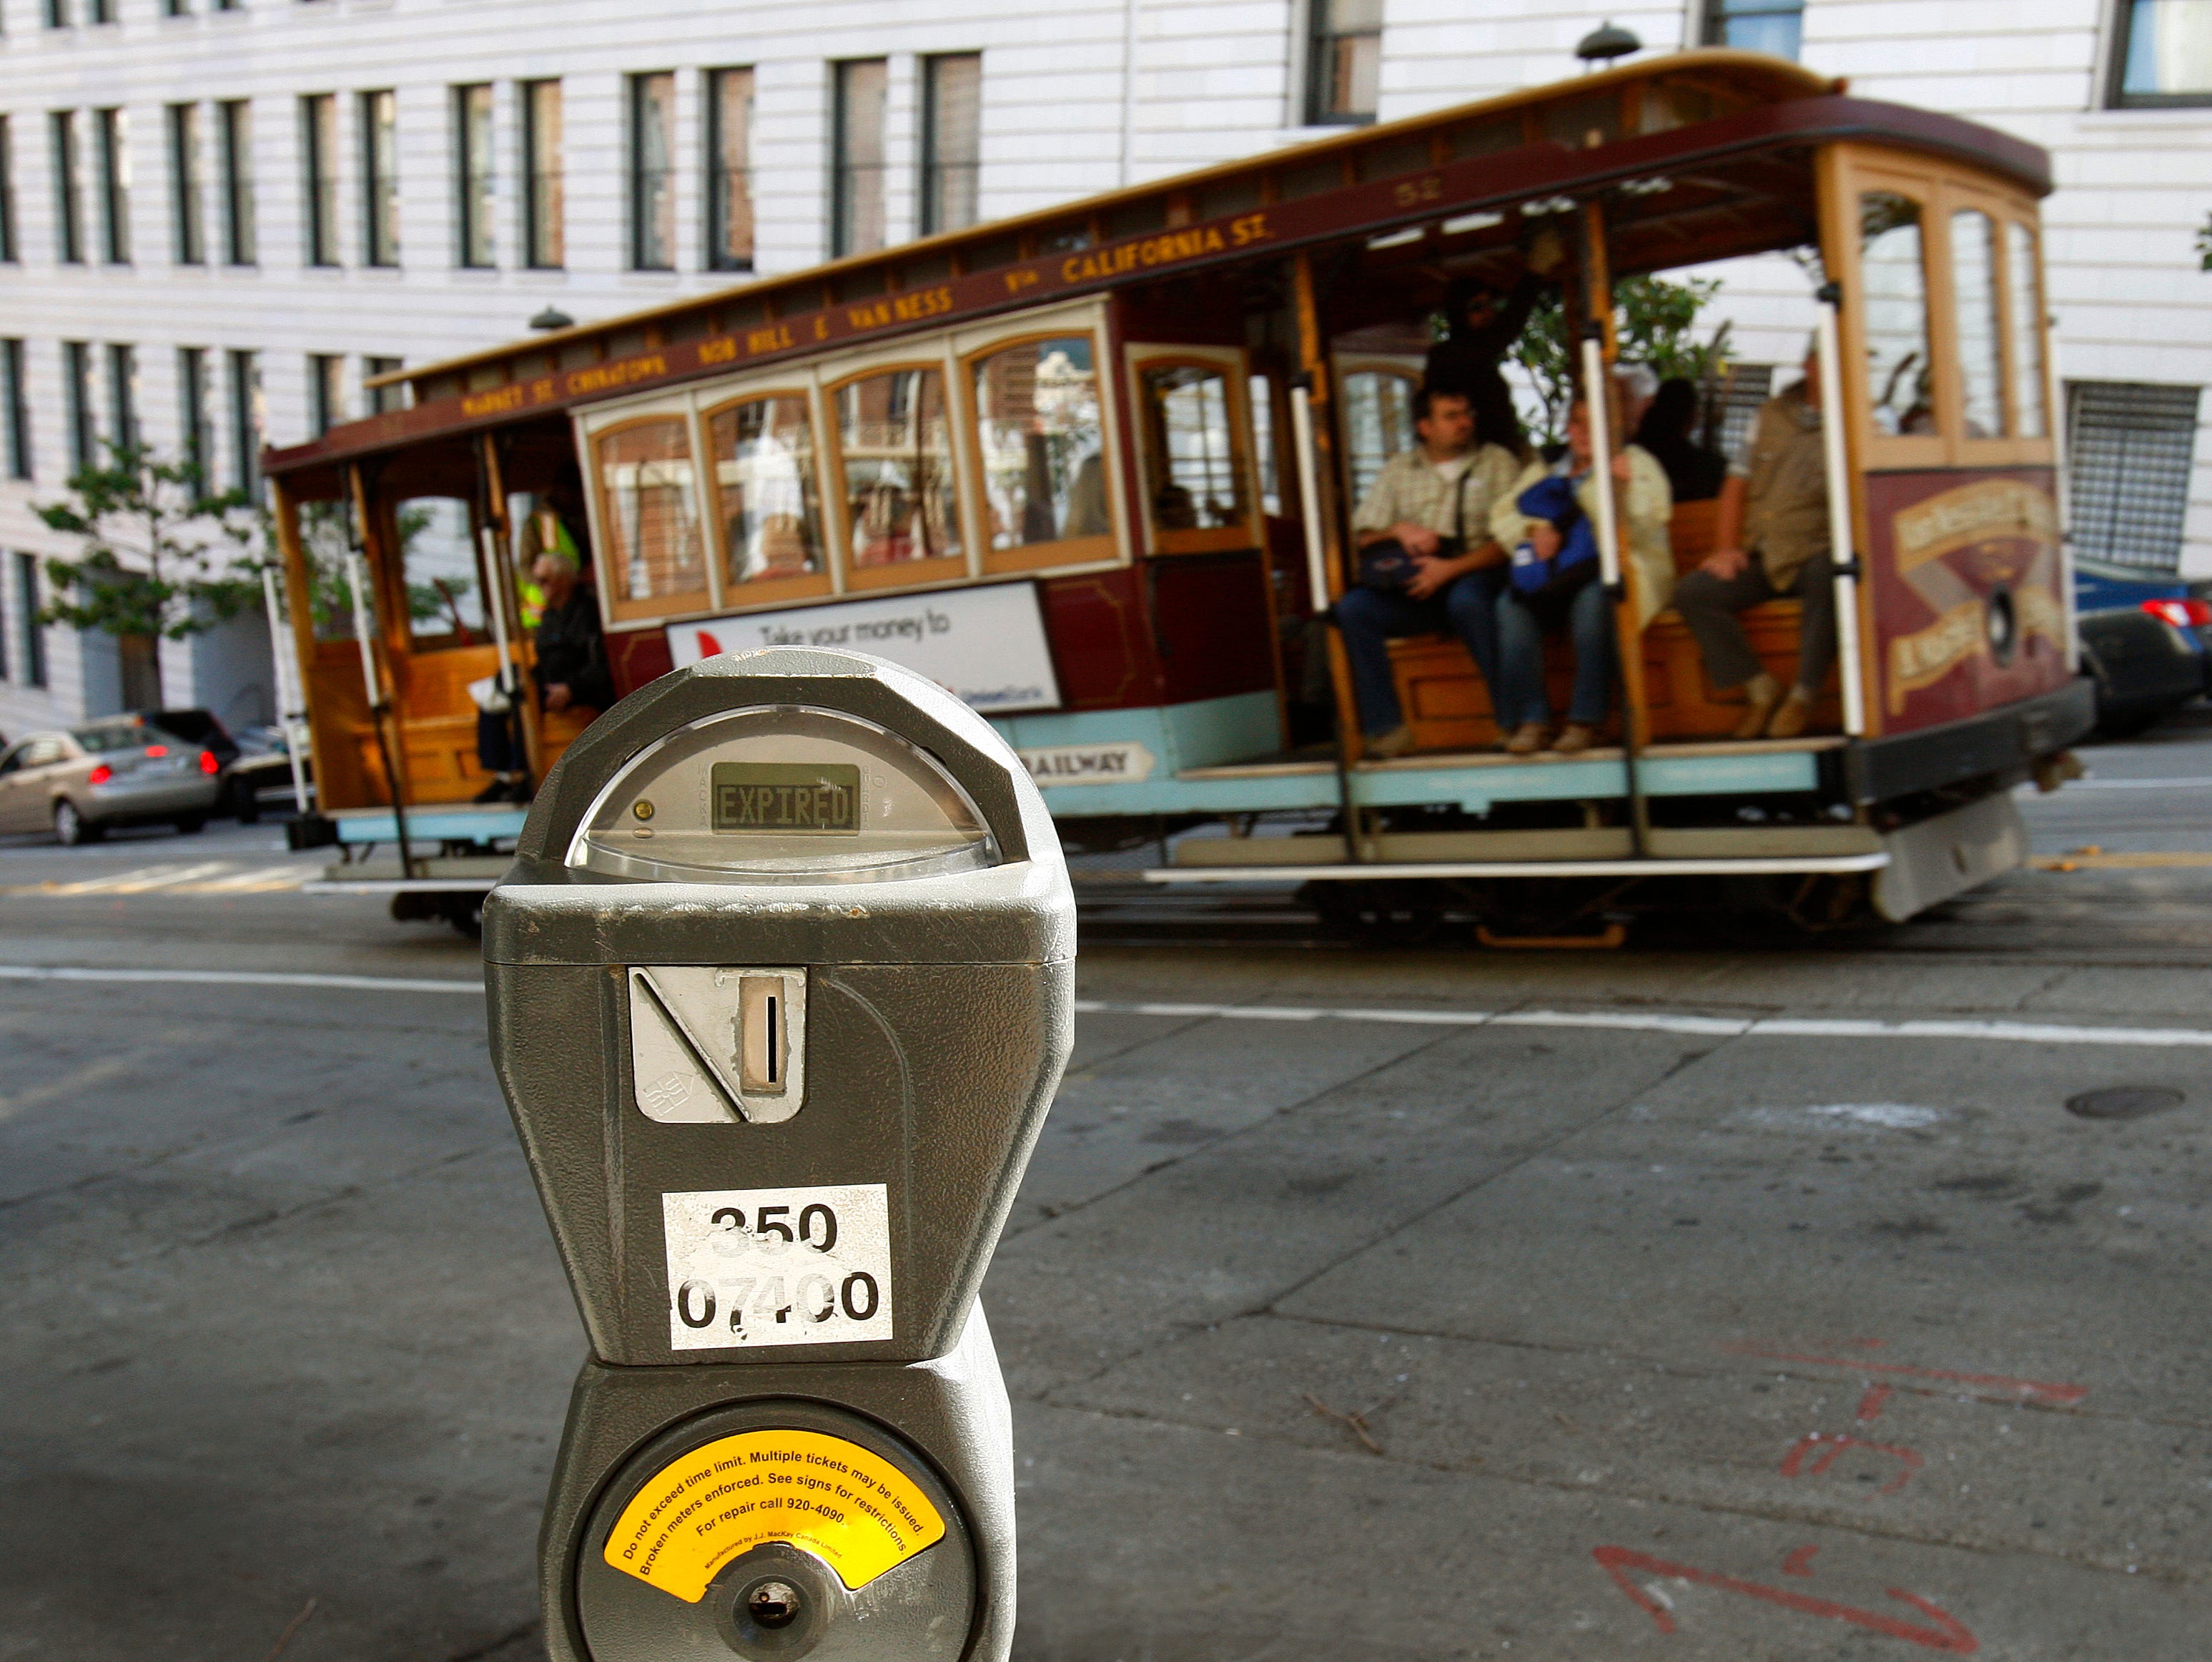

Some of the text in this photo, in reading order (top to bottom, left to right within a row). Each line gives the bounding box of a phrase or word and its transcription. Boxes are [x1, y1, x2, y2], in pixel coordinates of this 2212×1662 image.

[893, 286, 954, 322] NESS
[1062, 227, 1225, 282] CALIFORNIA
[759, 606, 951, 646] Take your money to
[720, 787, 847, 825] EXPIRED
[710, 1204, 838, 1257] 350
[623, 1450, 924, 1560] Do not exceed time limit. Multiple tickets may be issued.
[639, 1472, 907, 1575] Broken meters enforced. See signs for restrictions.
[696, 1498, 845, 1537] For repair call 920-4090.
[704, 1539, 743, 1570] Manufactured
[796, 1533, 820, 1545] Canada
